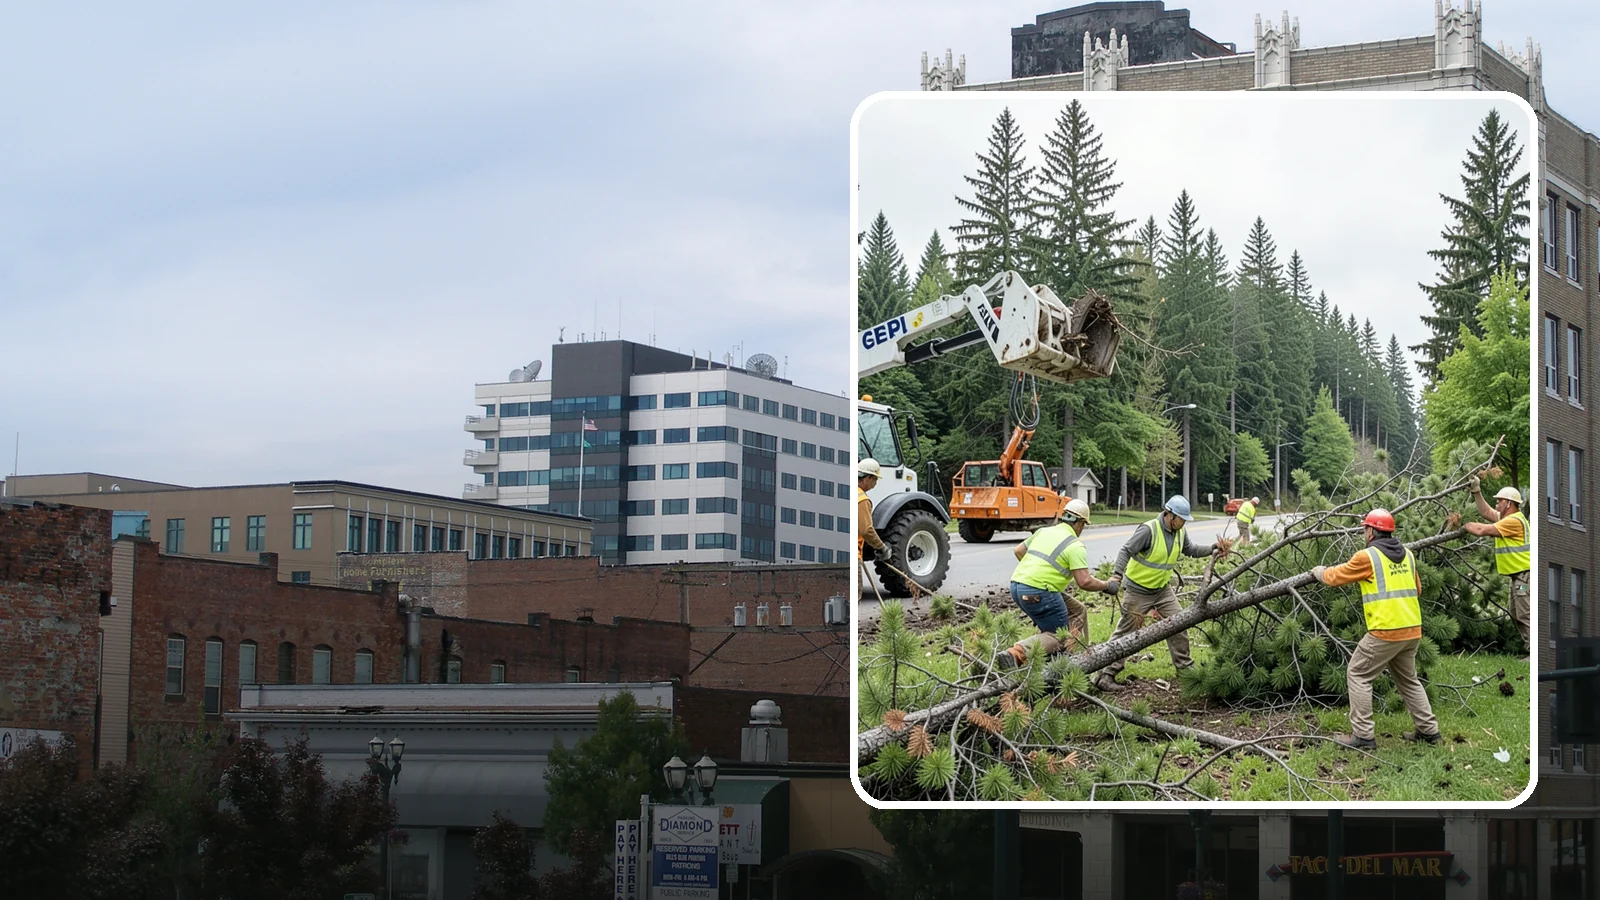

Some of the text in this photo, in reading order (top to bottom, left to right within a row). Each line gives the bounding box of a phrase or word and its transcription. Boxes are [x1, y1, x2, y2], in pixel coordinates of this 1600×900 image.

[862, 316, 908, 350] GEPI
[660, 818, 713, 833] DIAMOND
[1022, 814, 1070, 828] BUILDING
[719, 824, 740, 835] ETT
[656, 845, 716, 854] RESERVED PARKING
[719, 839, 740, 849] ANT
[616, 825, 625, 894] PAY HERE
[627, 825, 637, 893] PAY HERE
[671, 862, 701, 870] PATRONS
[1289, 855, 1441, 877] TAC DEL MAR
[660, 889, 710, 898] PUBLIC PARKING
